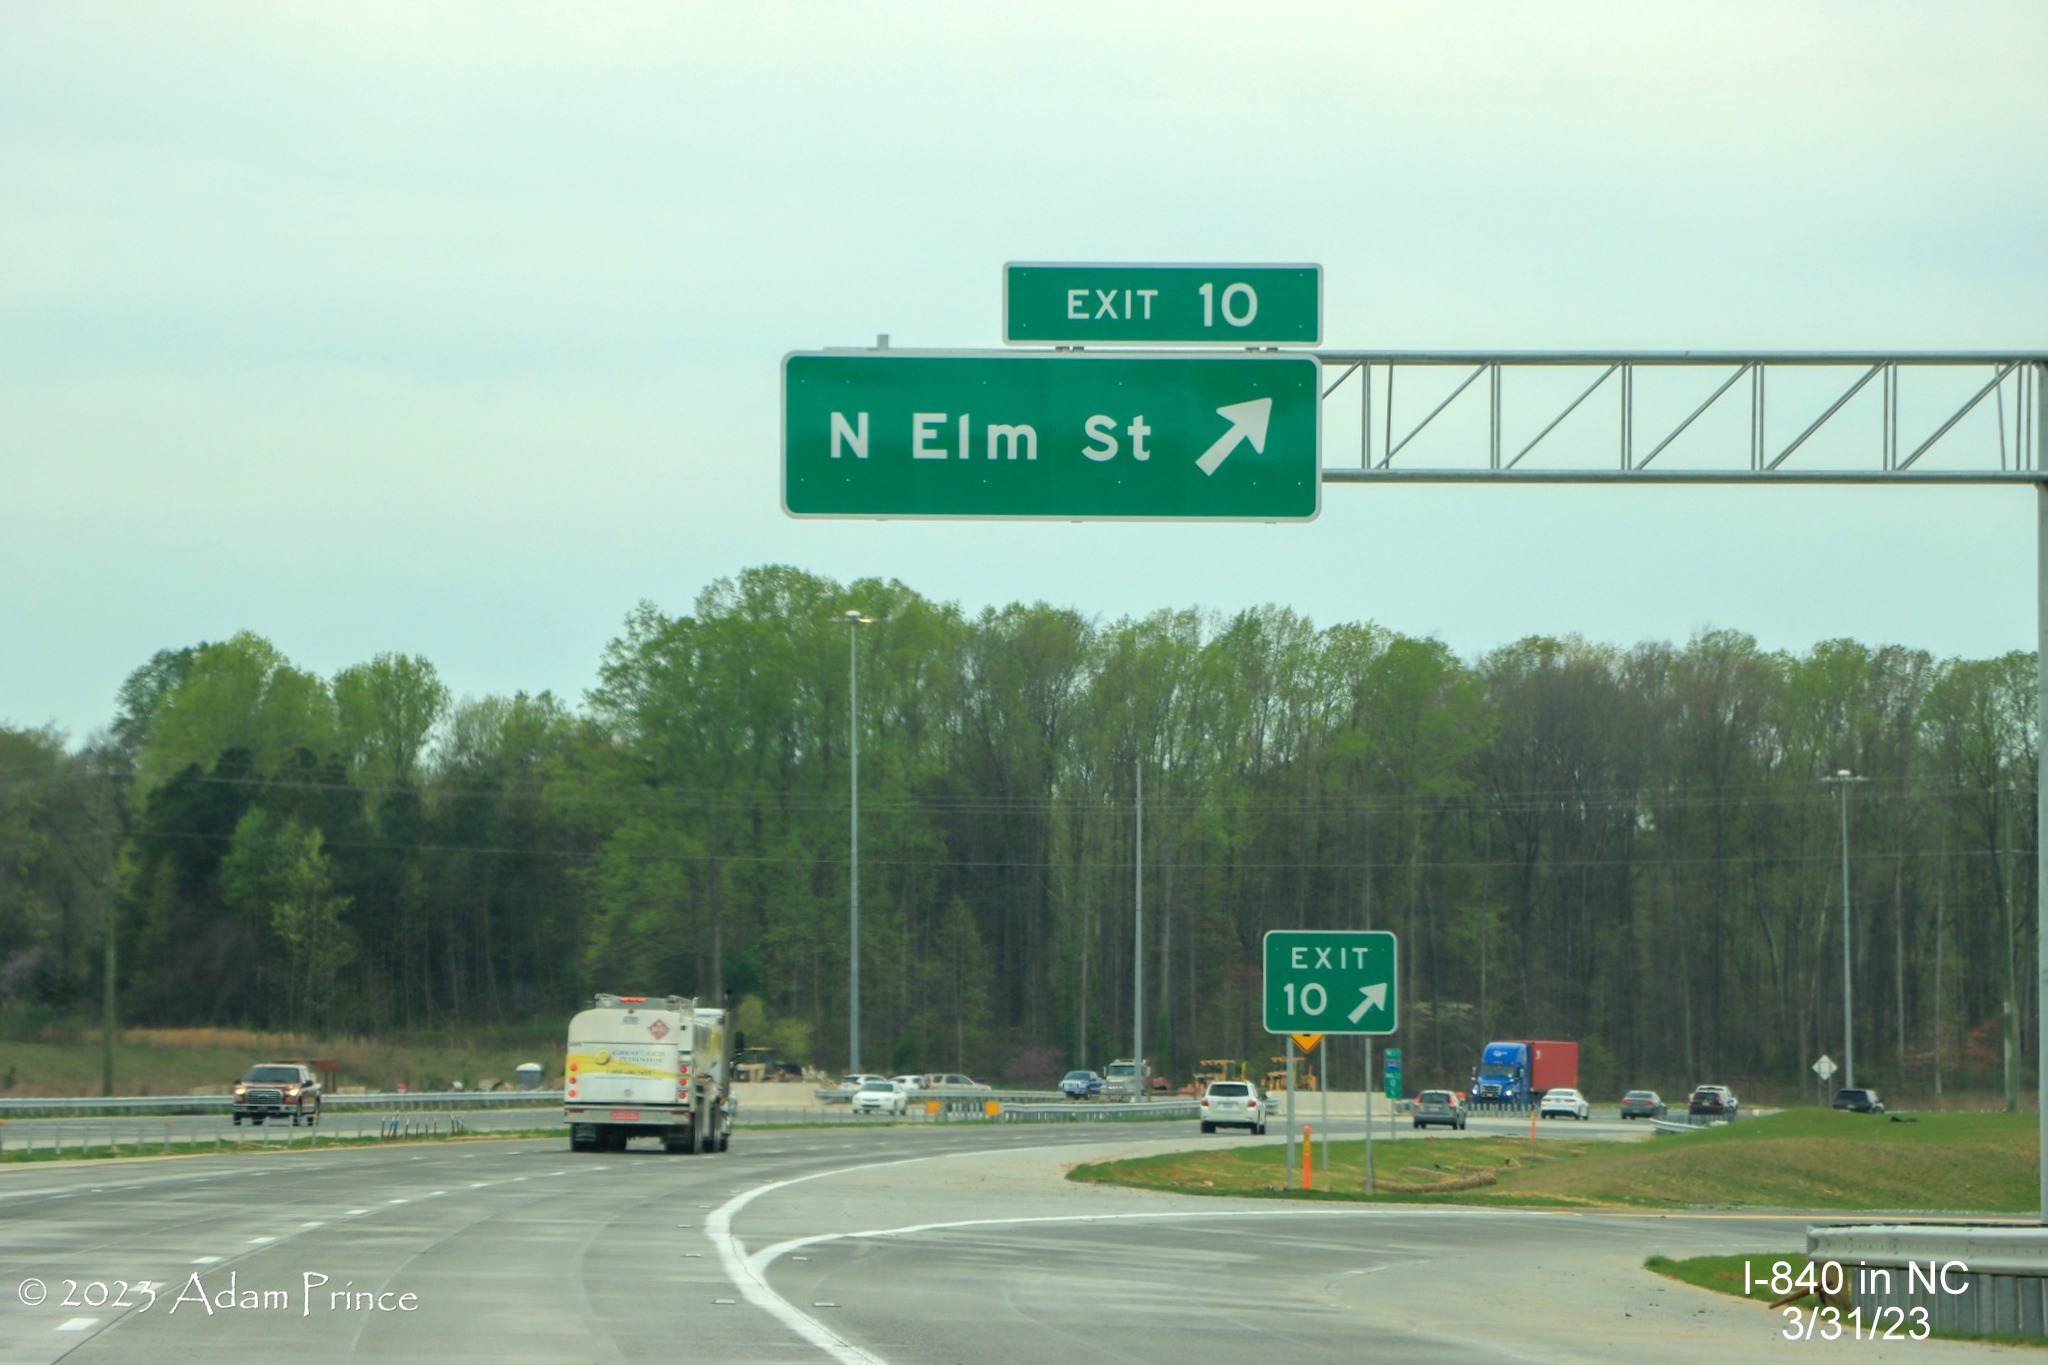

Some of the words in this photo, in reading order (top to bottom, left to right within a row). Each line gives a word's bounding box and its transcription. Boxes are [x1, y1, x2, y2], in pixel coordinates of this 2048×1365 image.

[1067, 289, 1159, 319] EXIT
[1199, 282, 1258, 327] 10
[830, 411, 869, 458] N
[912, 412, 1037, 460] Elm
[1082, 414, 1151, 461] St
[1291, 947, 1368, 969] EXIT
[1283, 982, 1327, 1016] 10
